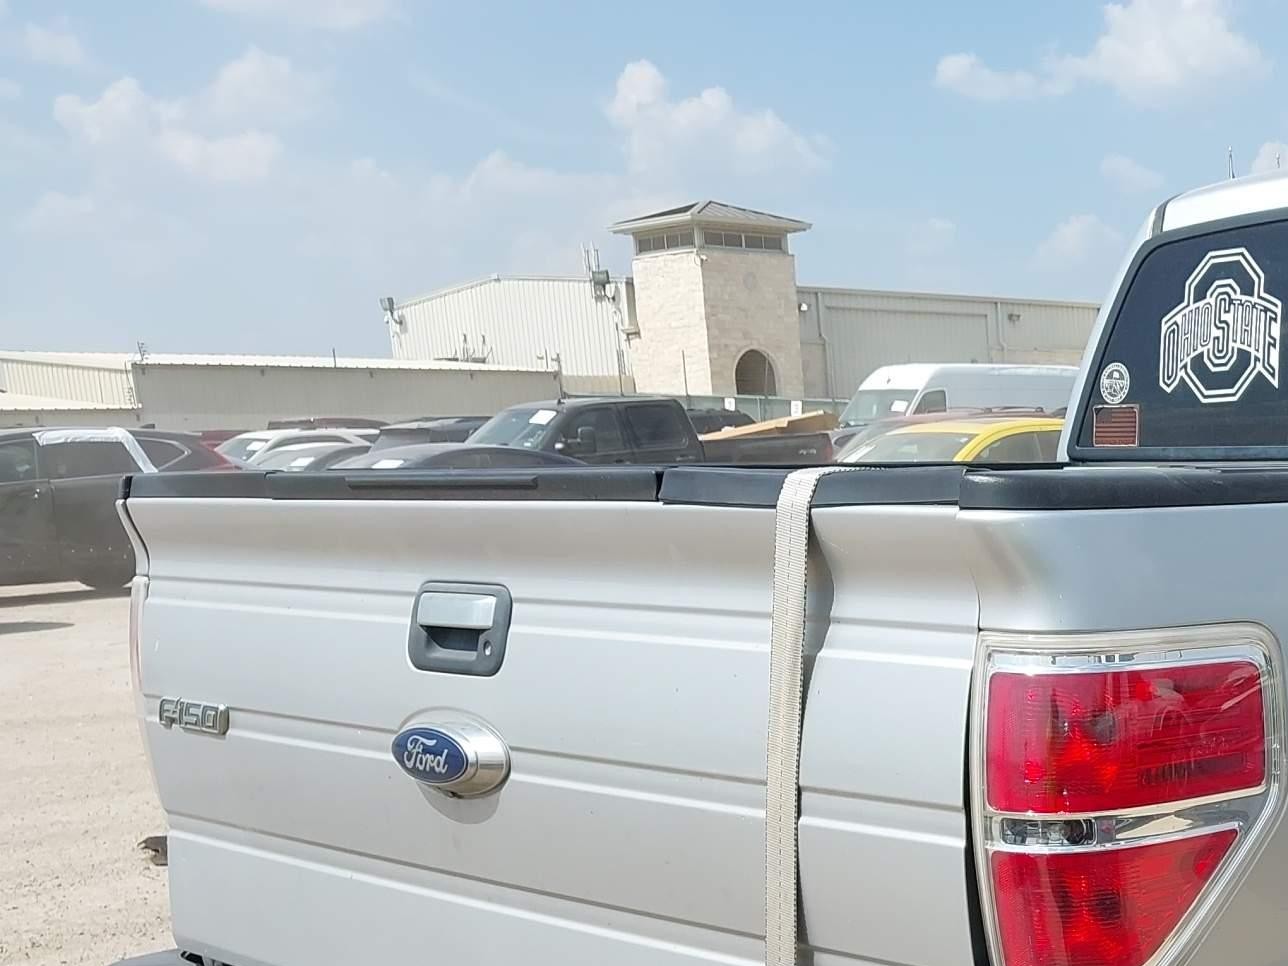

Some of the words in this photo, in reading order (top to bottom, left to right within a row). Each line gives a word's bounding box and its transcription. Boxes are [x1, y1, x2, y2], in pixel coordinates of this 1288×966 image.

[1162, 302, 1213, 391] OHIO
[1211, 289, 1279, 378] STATE
[403, 734, 449, 775] Ford
